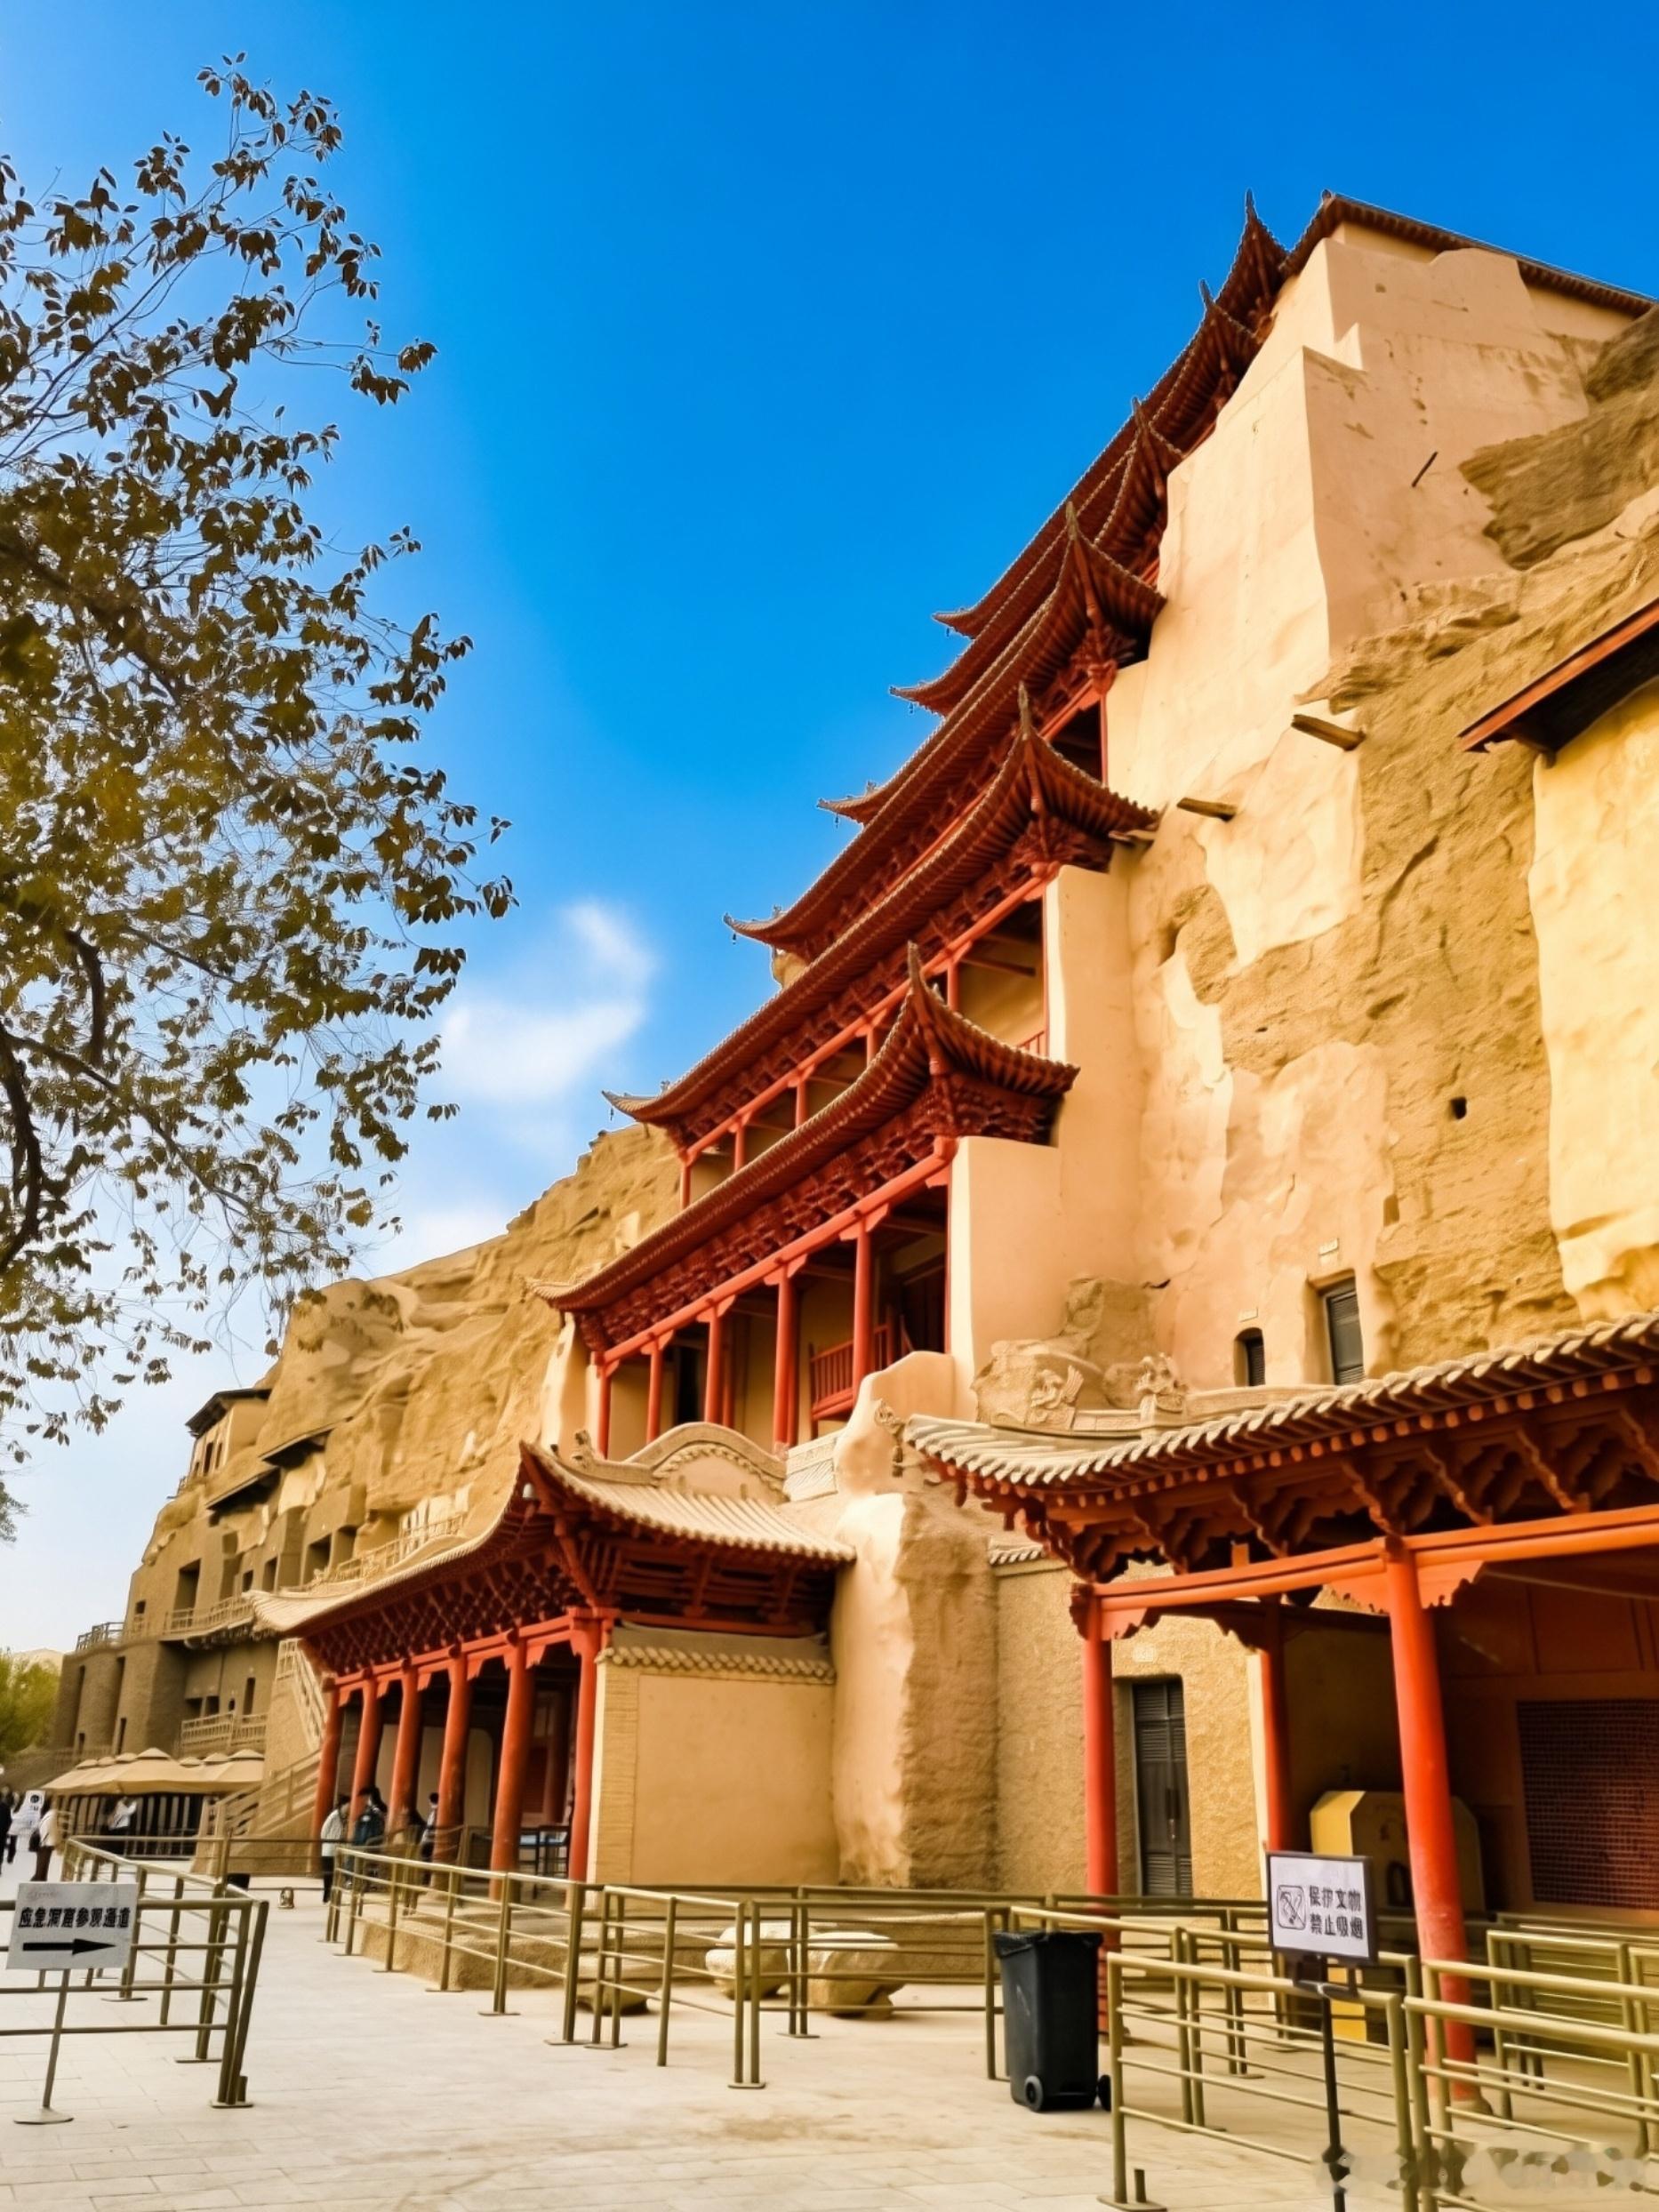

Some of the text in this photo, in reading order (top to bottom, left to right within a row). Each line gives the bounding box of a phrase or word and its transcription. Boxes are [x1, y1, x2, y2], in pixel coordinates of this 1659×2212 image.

[1309, 1885, 1361, 1911] 保护文物
[1310, 1912, 1363, 1939] 禁止吸烟
